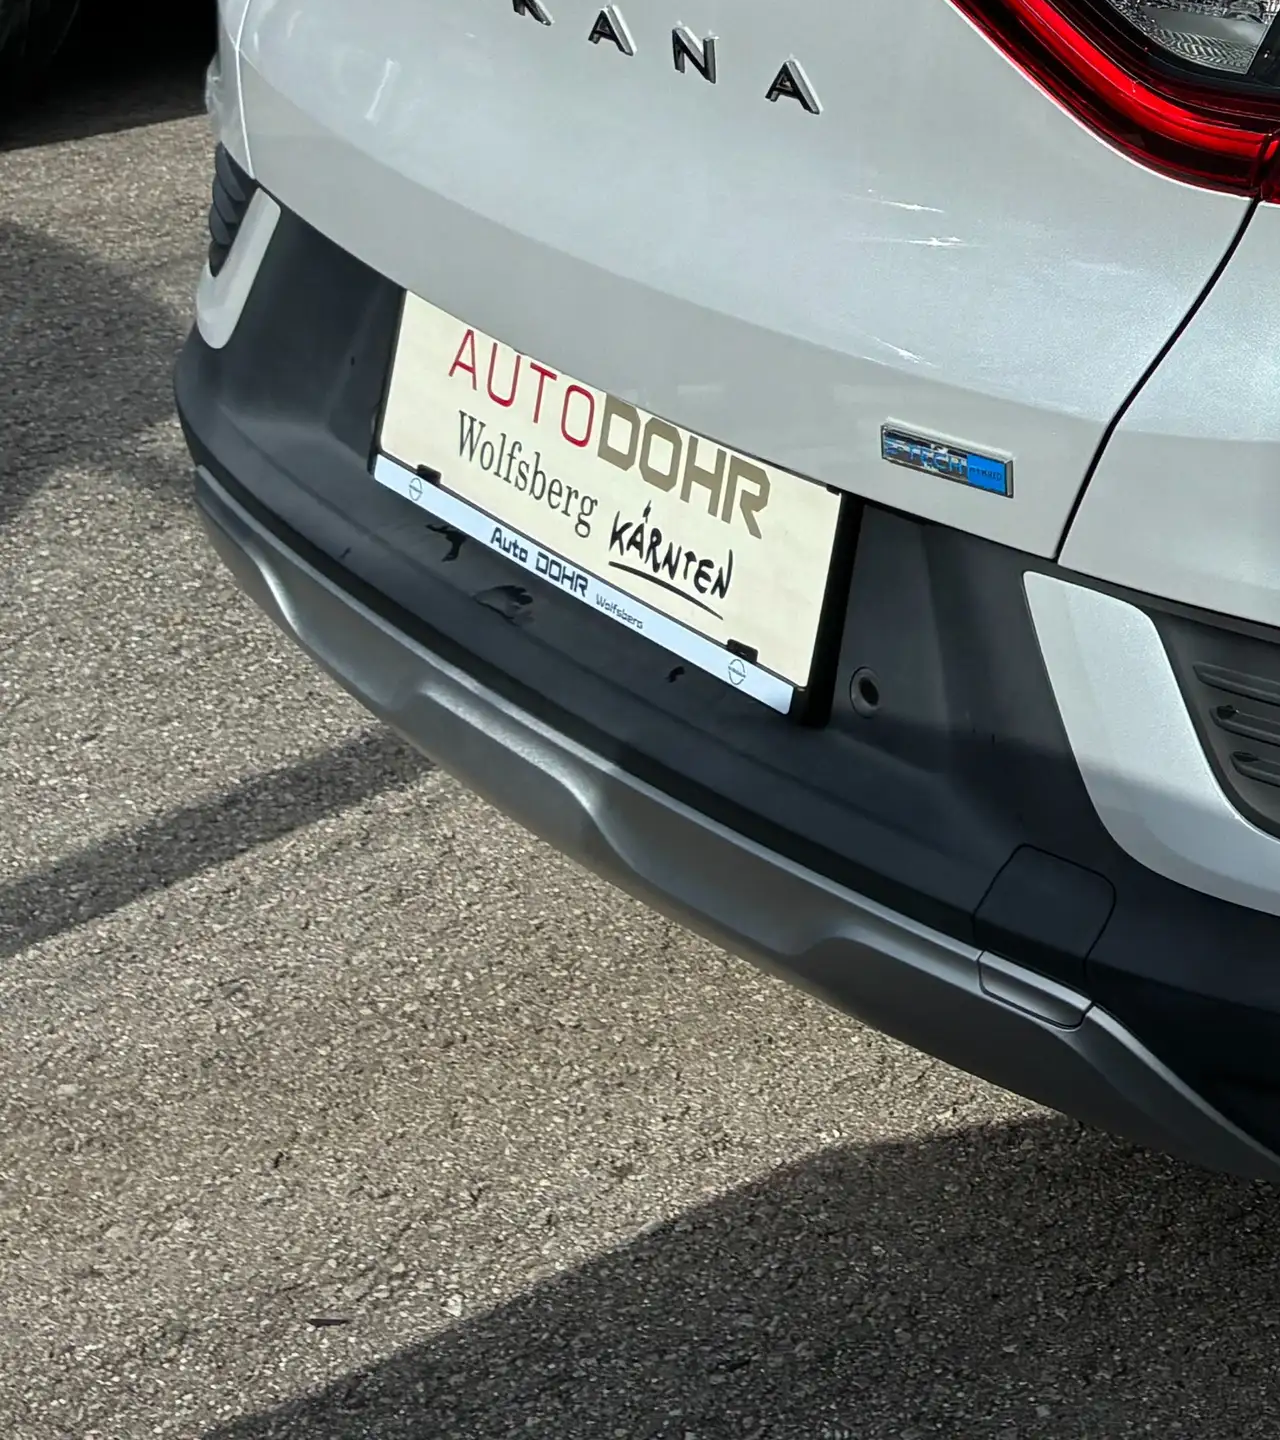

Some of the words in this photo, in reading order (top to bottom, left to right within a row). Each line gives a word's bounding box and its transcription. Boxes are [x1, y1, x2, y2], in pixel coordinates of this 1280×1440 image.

[458, 410, 598, 538] Wolfsberg
[490, 526, 529, 563] Auto
[535, 551, 589, 598] DOHR
[596, 593, 644, 630] Wolfsberg
